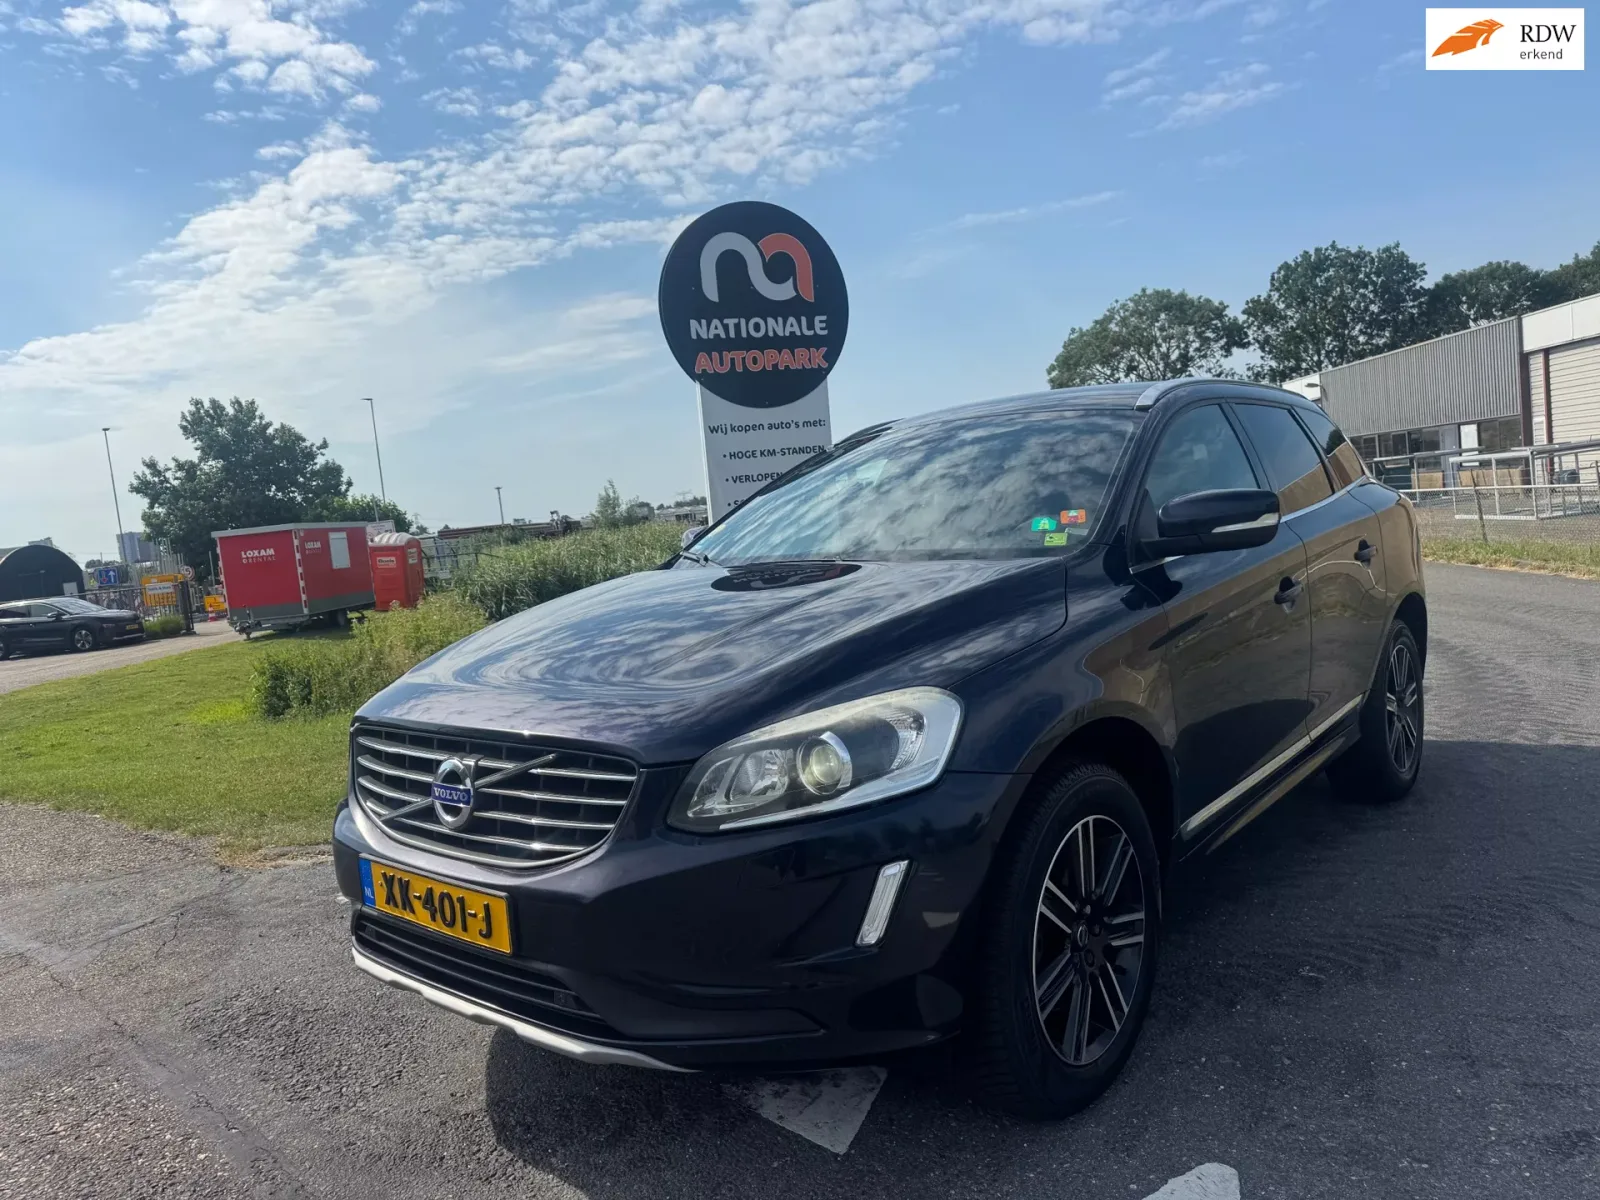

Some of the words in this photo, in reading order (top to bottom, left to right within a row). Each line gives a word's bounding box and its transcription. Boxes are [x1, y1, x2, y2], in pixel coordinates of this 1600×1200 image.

[689, 315, 829, 340] NATIONALE
[694, 347, 829, 374] AUTOPARK
[708, 424, 728, 435] Wij
[730, 423, 765, 434] kopen
[767, 420, 800, 430] auto's
[802, 418, 826, 428] met:
[729, 449, 758, 460] HOGE
[760, 445, 825, 458] KM-STANDEN
[241, 548, 275, 558] LOXAM
[433, 786, 469, 801] VOLVO
[364, 886, 375, 899] NL
[380, 870, 493, 939] XK-401-J
